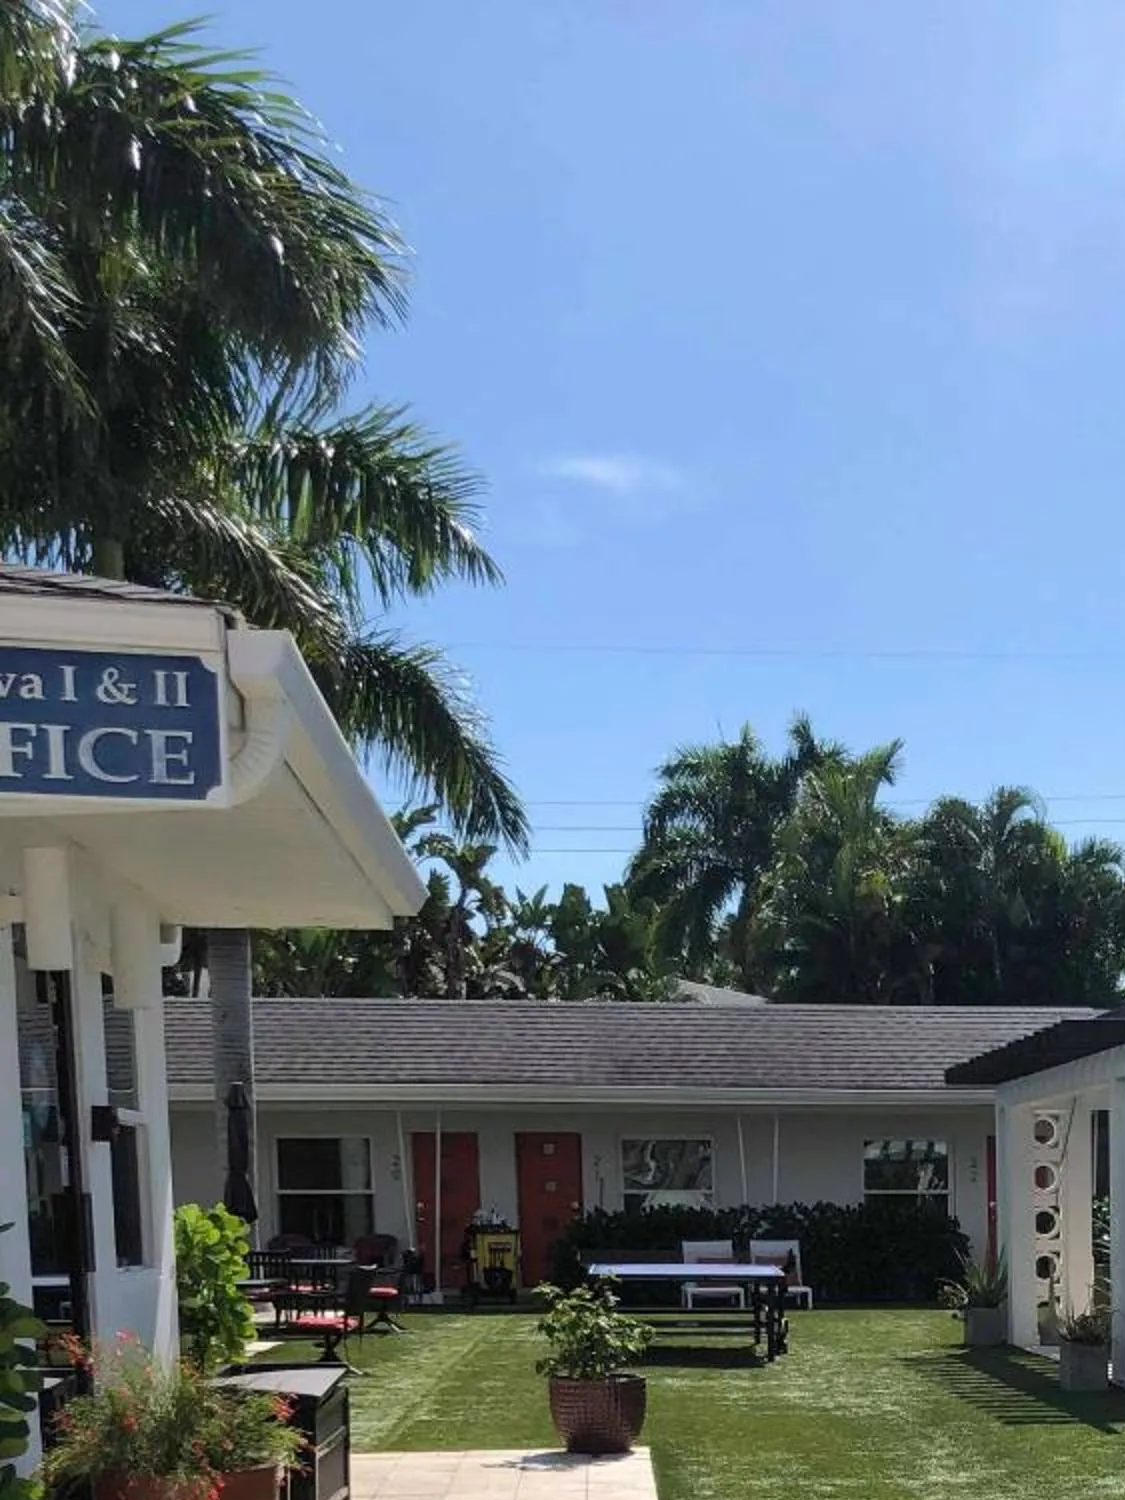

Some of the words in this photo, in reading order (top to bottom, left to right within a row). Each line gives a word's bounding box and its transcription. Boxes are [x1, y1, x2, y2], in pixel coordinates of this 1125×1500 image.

[59, 665, 79, 702] I
[96, 667, 138, 705] &
[154, 670, 191, 707] II
[0, 721, 195, 786] FICE
